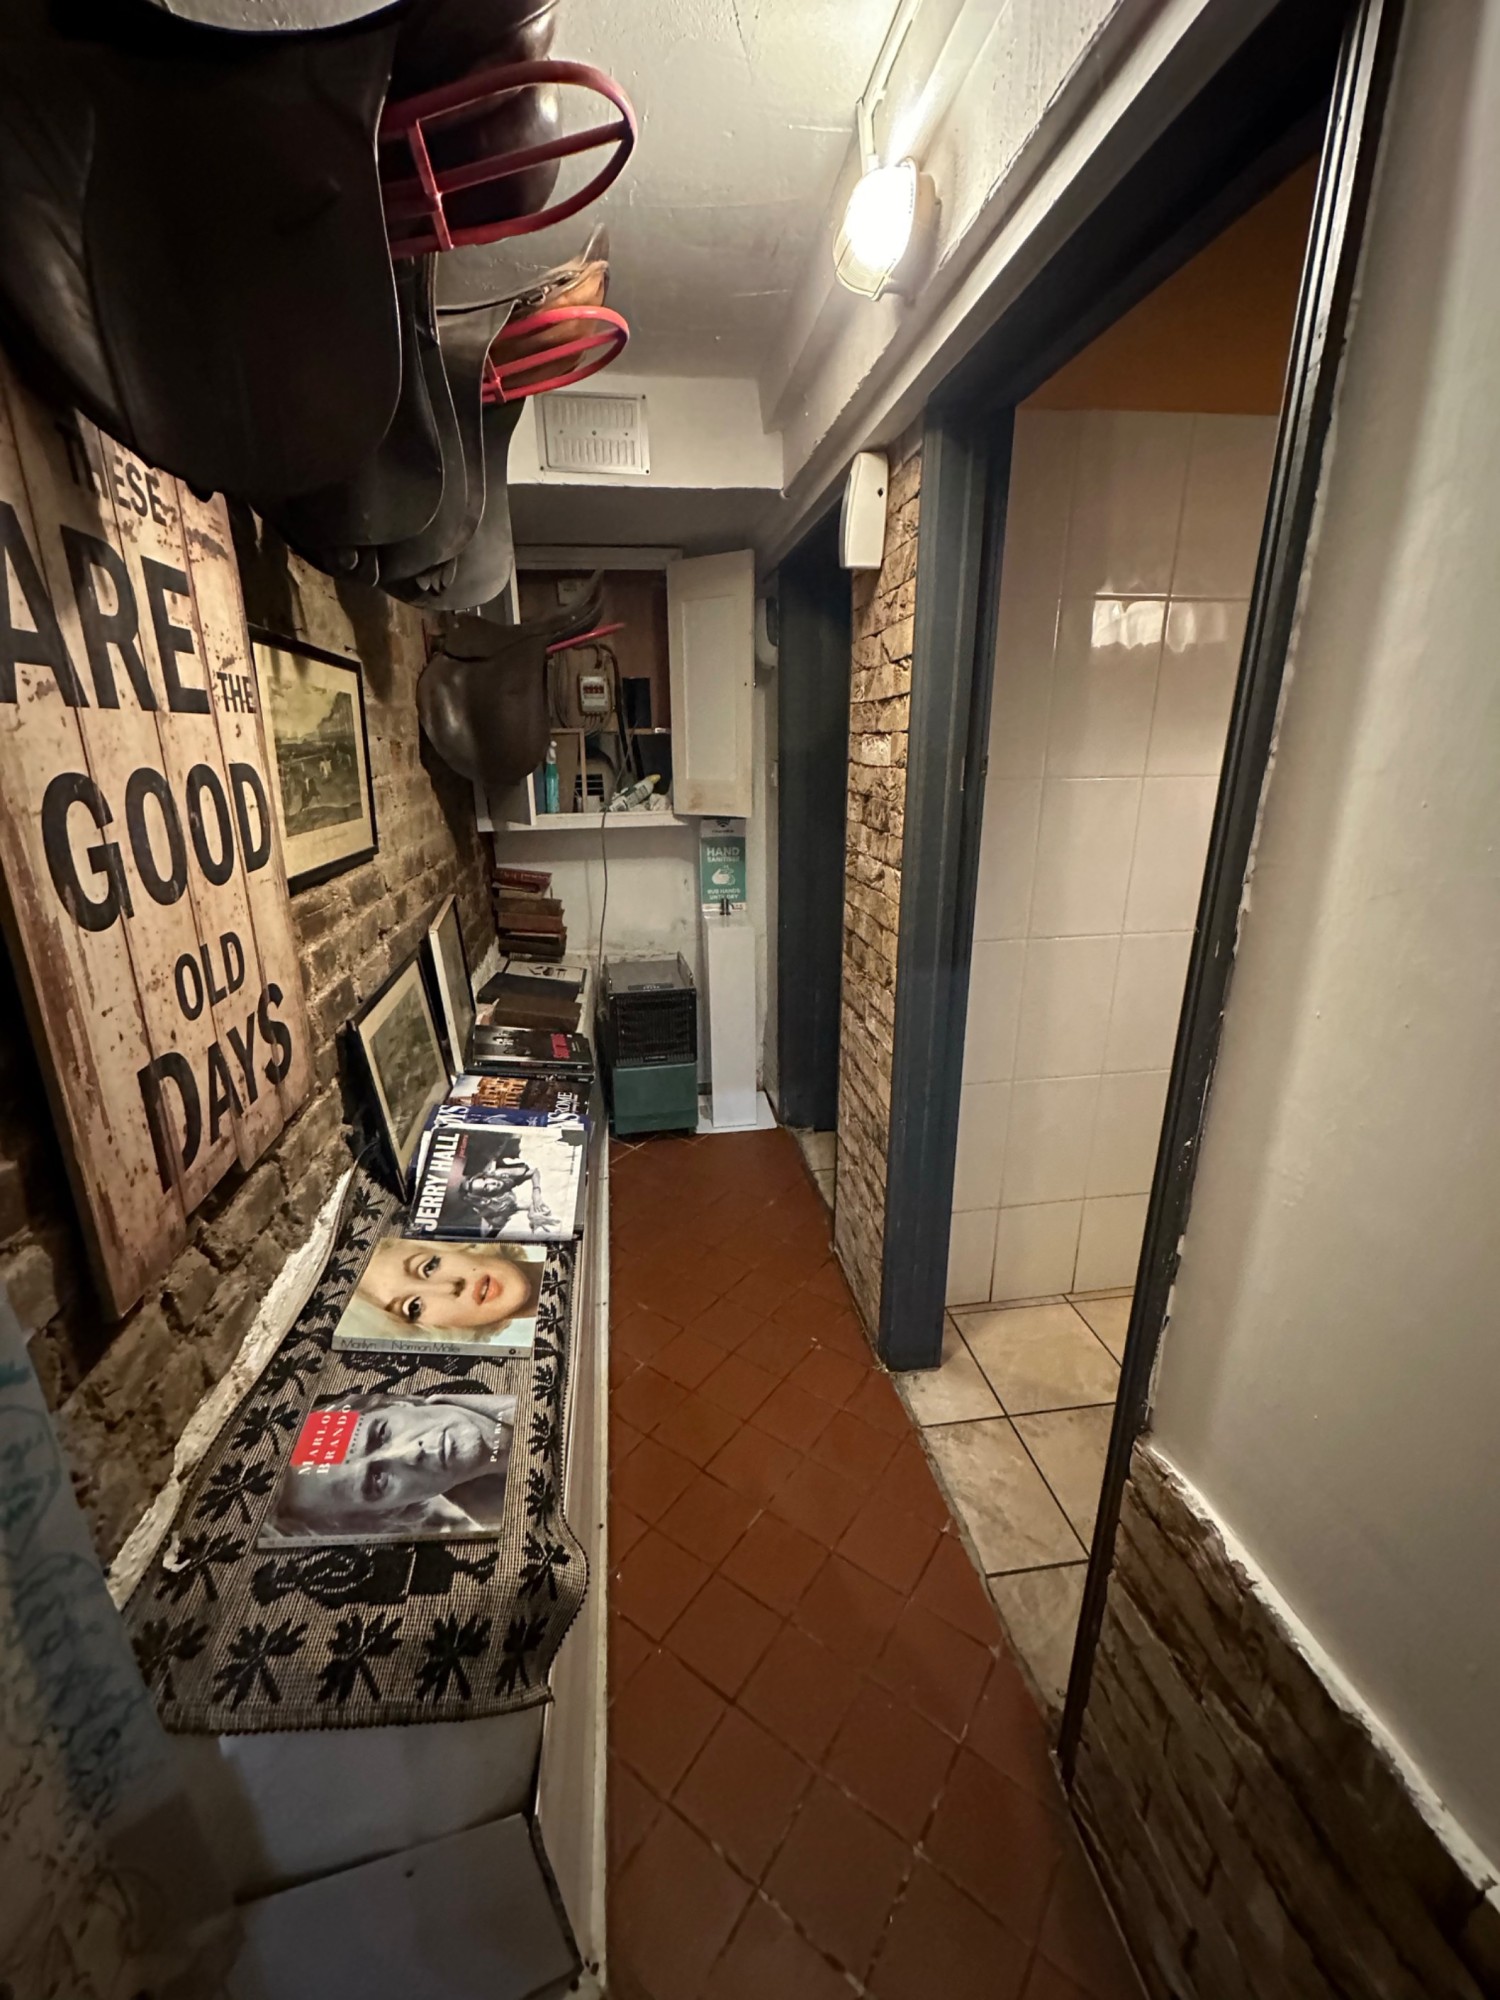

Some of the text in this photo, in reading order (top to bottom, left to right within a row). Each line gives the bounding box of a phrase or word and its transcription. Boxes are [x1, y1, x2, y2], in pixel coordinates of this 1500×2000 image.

[55, 421, 168, 526] THESE
[0, 502, 211, 715] ARE
[216, 671, 258, 714] THE
[41, 762, 272, 932] GOOD
[706, 846, 740, 857] HAND
[174, 931, 246, 1021] OLD
[136, 982, 293, 1194] DAYS
[429, 1132, 461, 1167] HALL
[414, 1173, 451, 1232] JERRY
[341, 1338, 462, 1353] Marilyn Norman Mailer
[298, 1404, 336, 1476] MARLON
[316, 1404, 352, 1474] BRANDO
